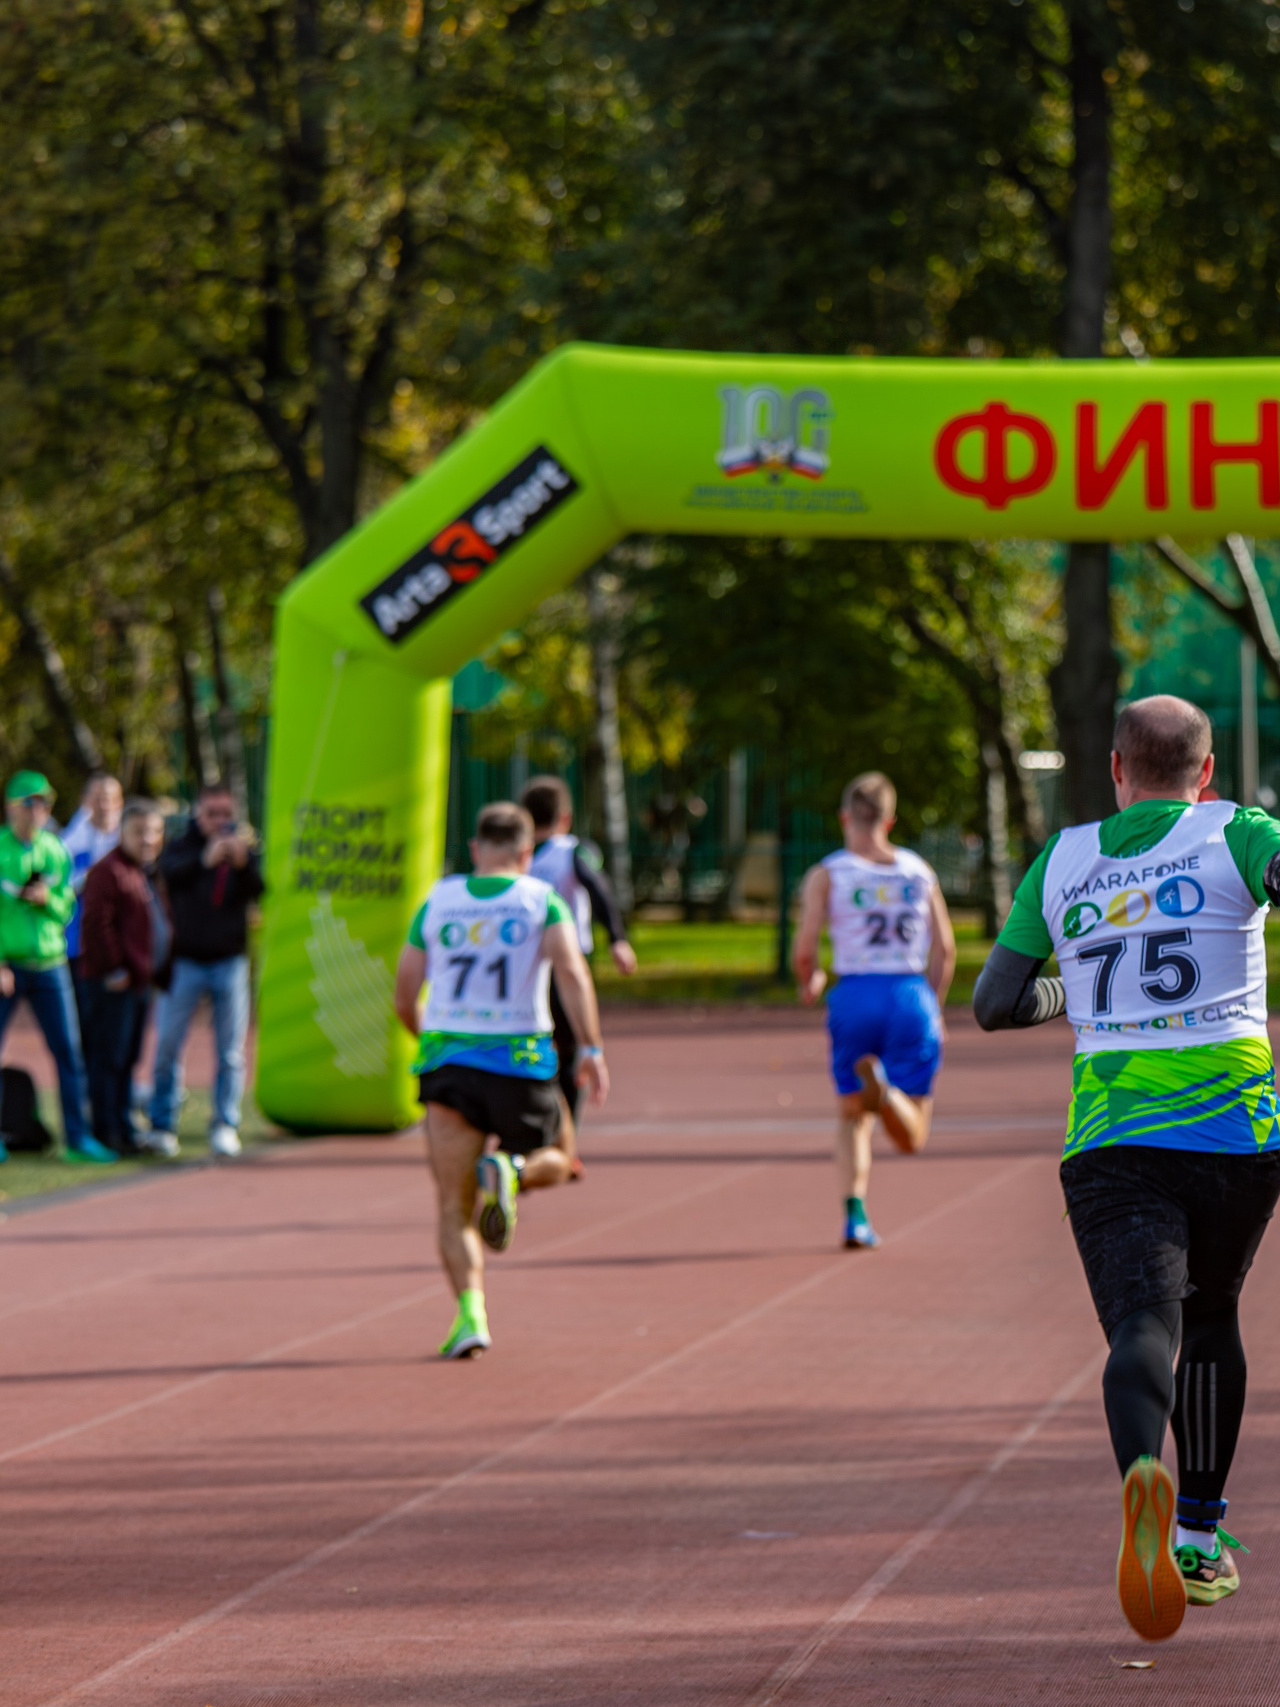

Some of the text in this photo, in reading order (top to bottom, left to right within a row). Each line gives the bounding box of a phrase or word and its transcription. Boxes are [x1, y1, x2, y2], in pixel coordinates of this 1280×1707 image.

[372, 459, 571, 636] Arta Sport
[1062, 856, 1200, 901] VMARAFONE
[866, 912, 917, 946] 26
[447, 953, 508, 1001] 71
[1075, 927, 1200, 1017] 75
